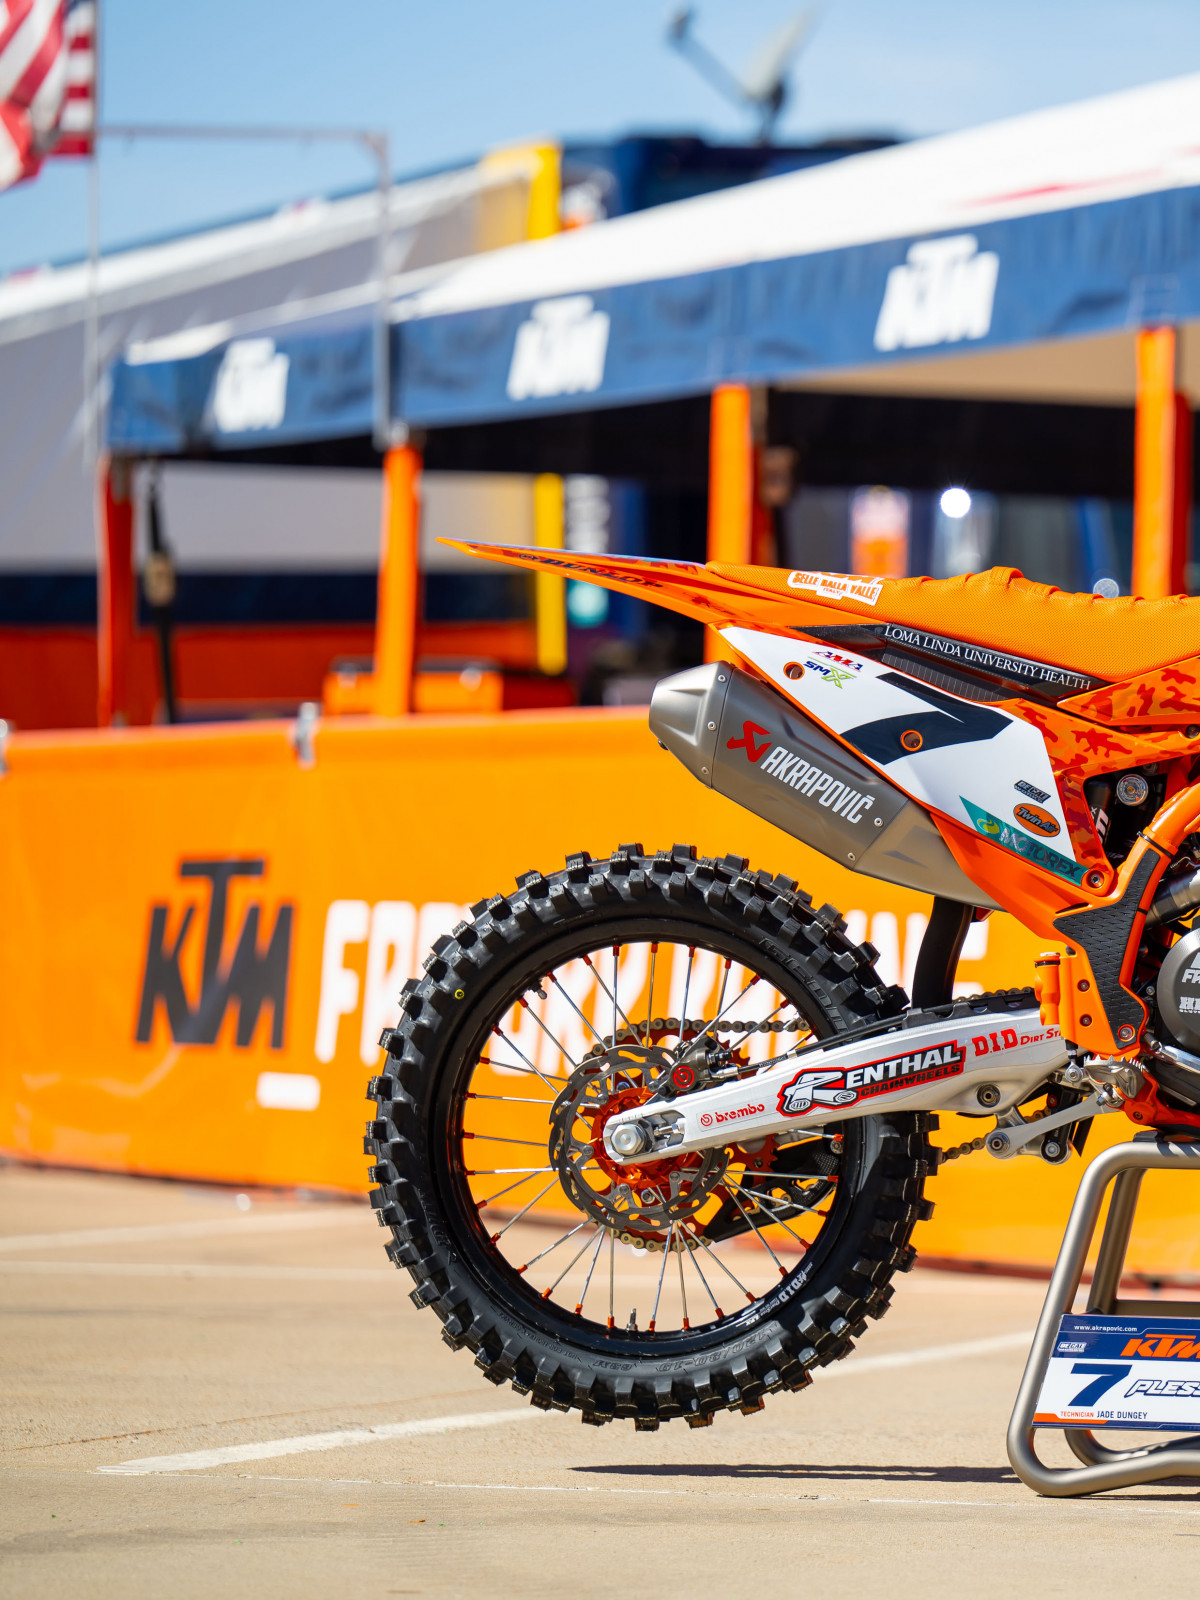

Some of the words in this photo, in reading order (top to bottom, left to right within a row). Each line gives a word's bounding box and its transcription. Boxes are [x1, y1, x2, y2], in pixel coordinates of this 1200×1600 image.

[874, 234, 999, 351] KTM
[540, 559, 663, 587] DUNLOP
[792, 572, 819, 586] SELLE
[884, 625, 921, 646] LOMA
[922, 636, 962, 657] LINDA
[964, 648, 1037, 678] UNIVERSITY
[1039, 668, 1091, 690] HEALTH
[840, 672, 1014, 766] 7
[1016, 806, 1042, 826] Twin
[1040, 821, 1059, 834] Air
[999, 827, 1082, 880] MOTOREX
[137, 861, 292, 1048] KTM
[783, 1044, 964, 1111] RENTHAL
[859, 1063, 961, 1097] CHAINWHEELS
[714, 1102, 766, 1124] brembo
[1073, 1324, 1138, 1332] www.akrapovic.com
[1068, 1362, 1133, 1407] 7
[1060, 1410, 1095, 1418] TECHNICIAN
[1096, 1410, 1115, 1420] JADE
[1116, 1410, 1148, 1420] DUNGEY
